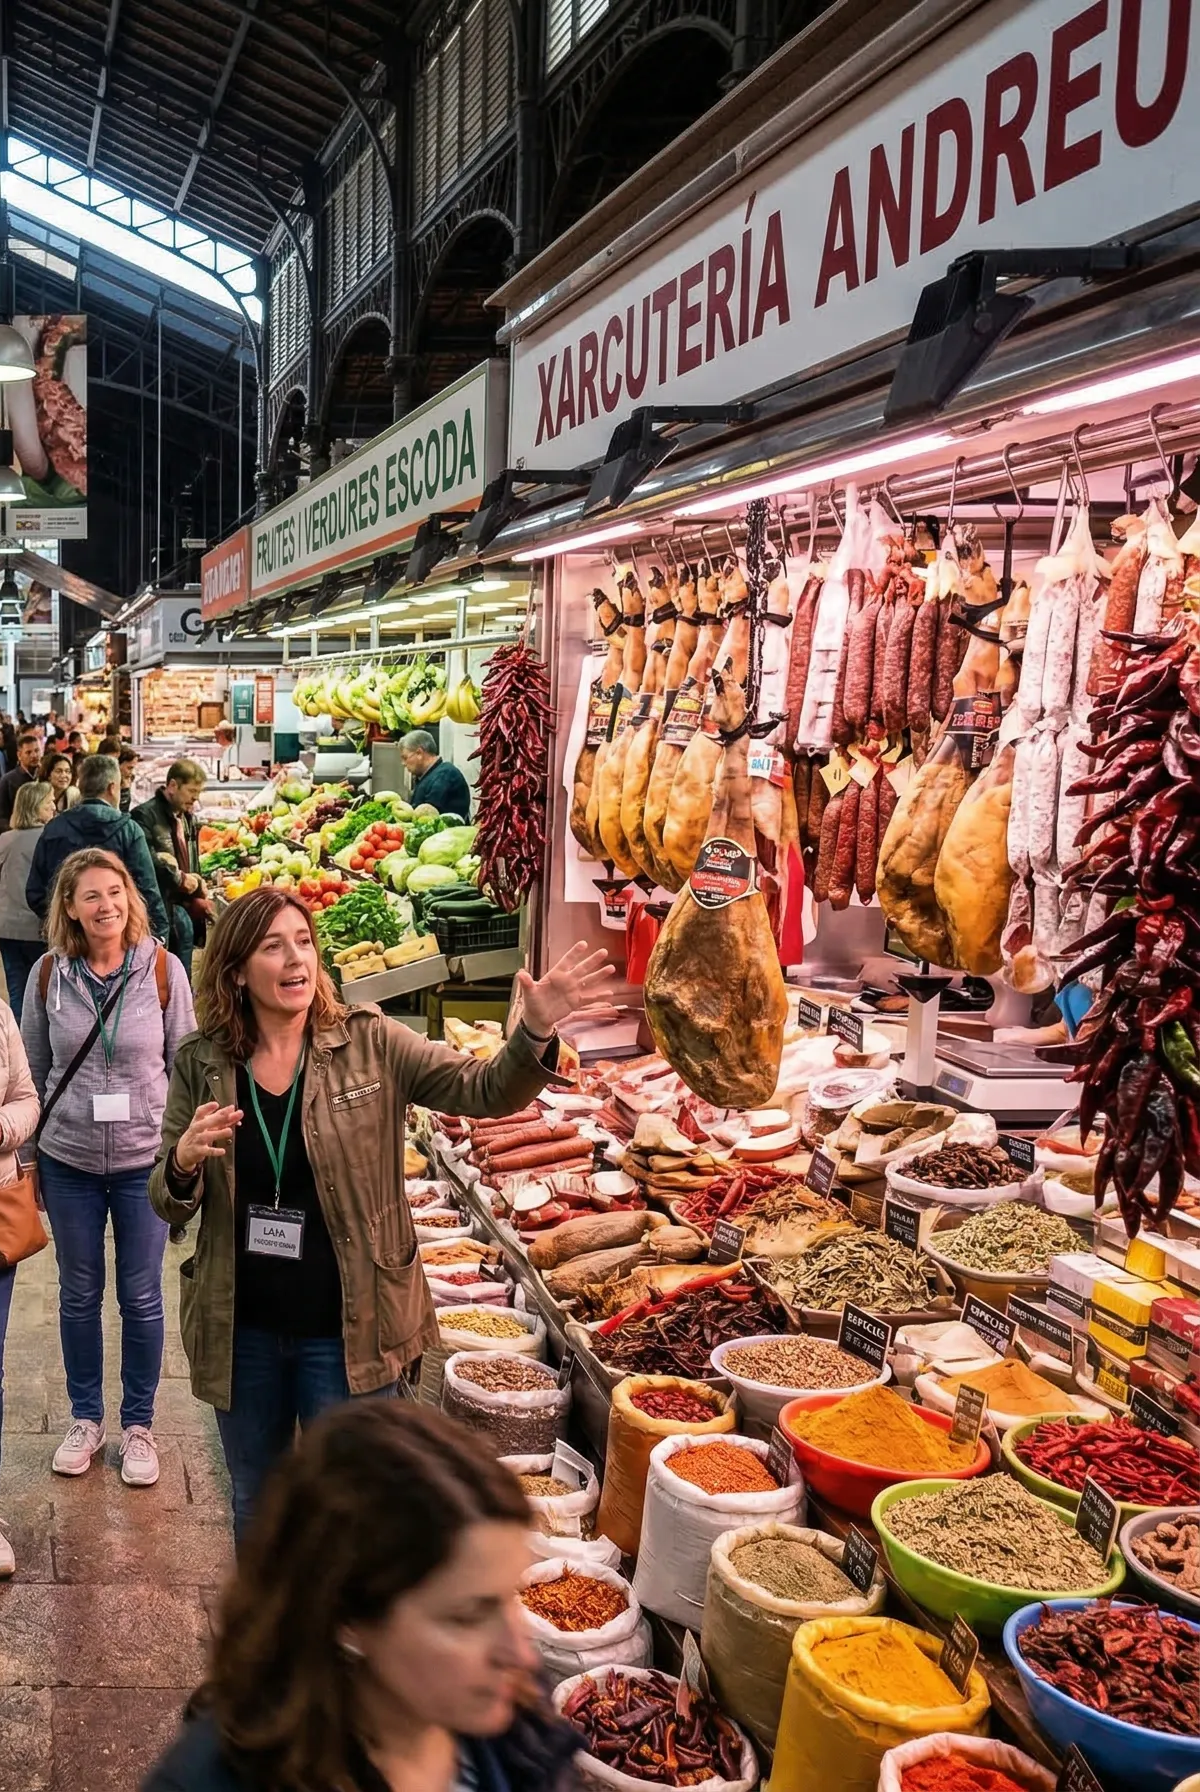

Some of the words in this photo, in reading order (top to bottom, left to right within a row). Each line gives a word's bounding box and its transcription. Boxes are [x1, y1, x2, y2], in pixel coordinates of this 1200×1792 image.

[535, 190, 790, 447] XARCUTERÍA
[814, 0, 1190, 308] ANDREU
[256, 518, 296, 578] FRUITES
[303, 464, 380, 555] VERDURES
[385, 407, 477, 518] ESCODA
